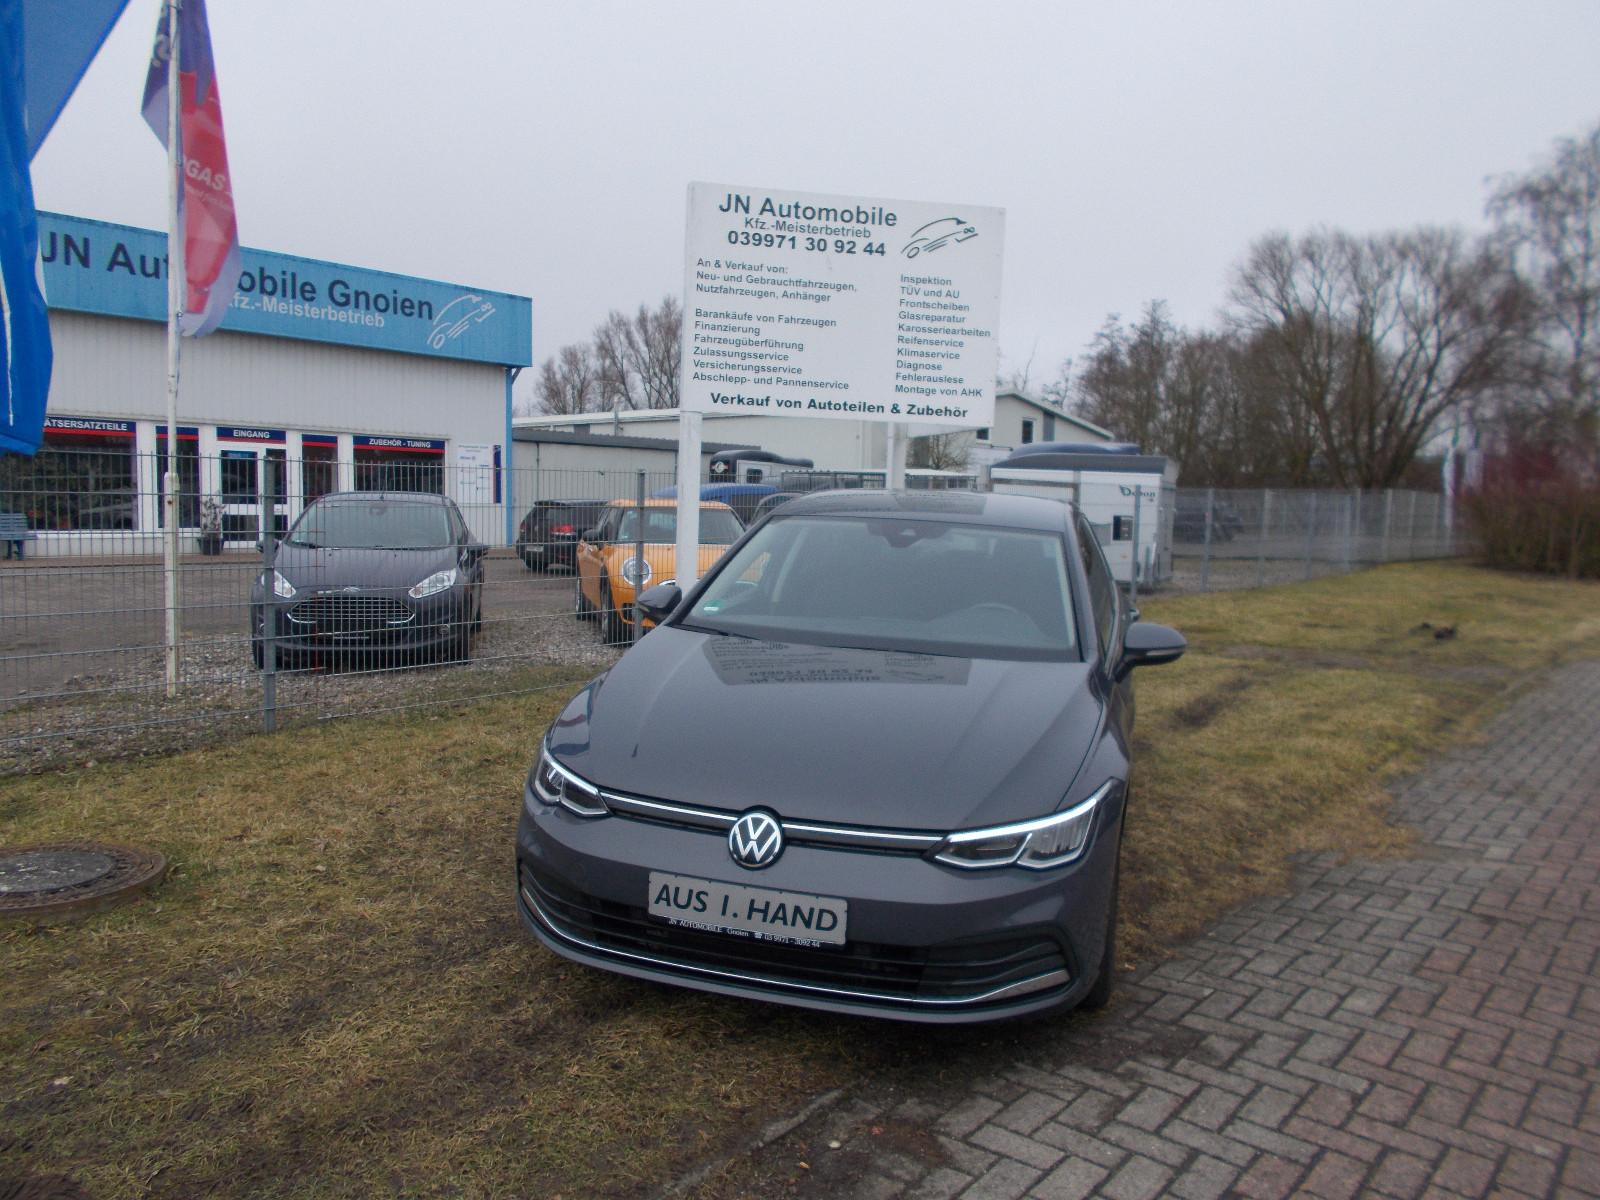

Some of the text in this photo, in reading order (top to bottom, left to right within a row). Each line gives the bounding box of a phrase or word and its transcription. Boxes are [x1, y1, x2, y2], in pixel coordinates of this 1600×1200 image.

[718, 193, 898, 227] JN Automobile
[744, 216, 872, 239] Kfz.-Meisterbetrieb
[727, 230, 886, 256] 039971 30 92 44
[697, 257, 788, 274] An & Verkauf von:
[42, 231, 91, 269] JN
[328, 279, 434, 321] Gnoien
[696, 271, 857, 292] Neu- und Gebrauchtfahrzeugen,
[900, 274, 952, 286] Inspektion
[696, 284, 831, 303] Nutzfahrzeugen, Anhänger
[900, 285, 960, 299] TÜV und AU
[229, 292, 385, 328] fz.-Meisterbetrieb
[899, 299, 970, 312] Frontscheiben
[695, 308, 837, 327] Barankäufe von Fahrzeugen
[898, 310, 966, 323] Glasreparatur
[694, 320, 761, 336] Finanzierung
[898, 323, 991, 337] Karosseriearbeiten
[694, 334, 804, 351] Fahrzeugüberführung
[897, 335, 964, 348] Reifenservice
[693, 347, 789, 361] Zulassungsservice
[897, 347, 961, 360] Klimaservice
[693, 359, 803, 375] Versicherungsservice
[896, 360, 943, 371] Diagnose
[692, 371, 850, 390] Abschlepp- und Pannenservice
[895, 372, 964, 384] Fehlerauslese
[895, 384, 983, 398] Montage von AHK
[710, 392, 969, 418] Verkauf von Autoteilen & Zubehör
[233, 429, 270, 439] EINGANG
[368, 438, 402, 447] ZUBEHÖR
[407, 440, 431, 449] TUNING
[654, 883, 709, 913] AUS
[746, 898, 839, 932] HAND
